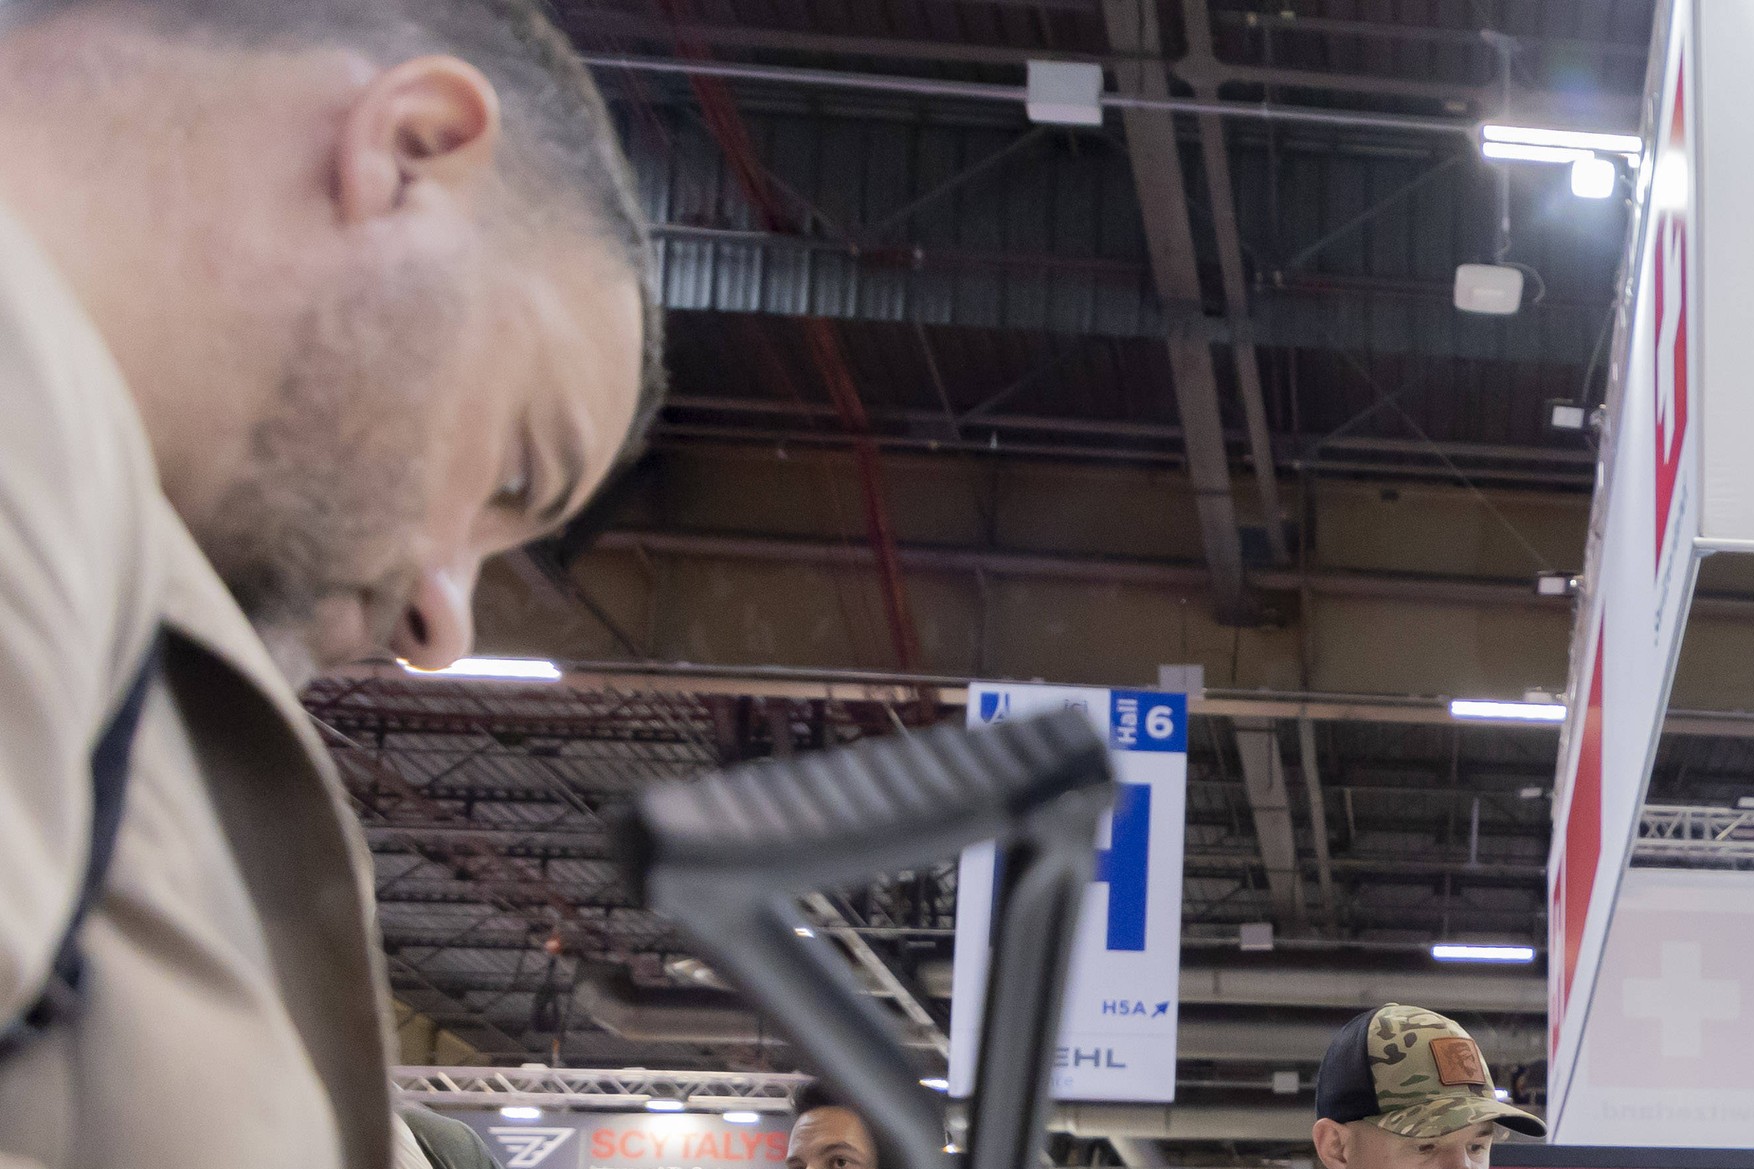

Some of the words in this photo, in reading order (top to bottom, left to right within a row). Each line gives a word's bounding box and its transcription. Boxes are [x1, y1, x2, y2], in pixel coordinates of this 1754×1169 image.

[1116, 699, 1138, 744] Hall
[1145, 705, 1174, 740] 6
[1102, 1000, 1147, 1016] H5A
[591, 1128, 790, 1162] SCYTALYS
